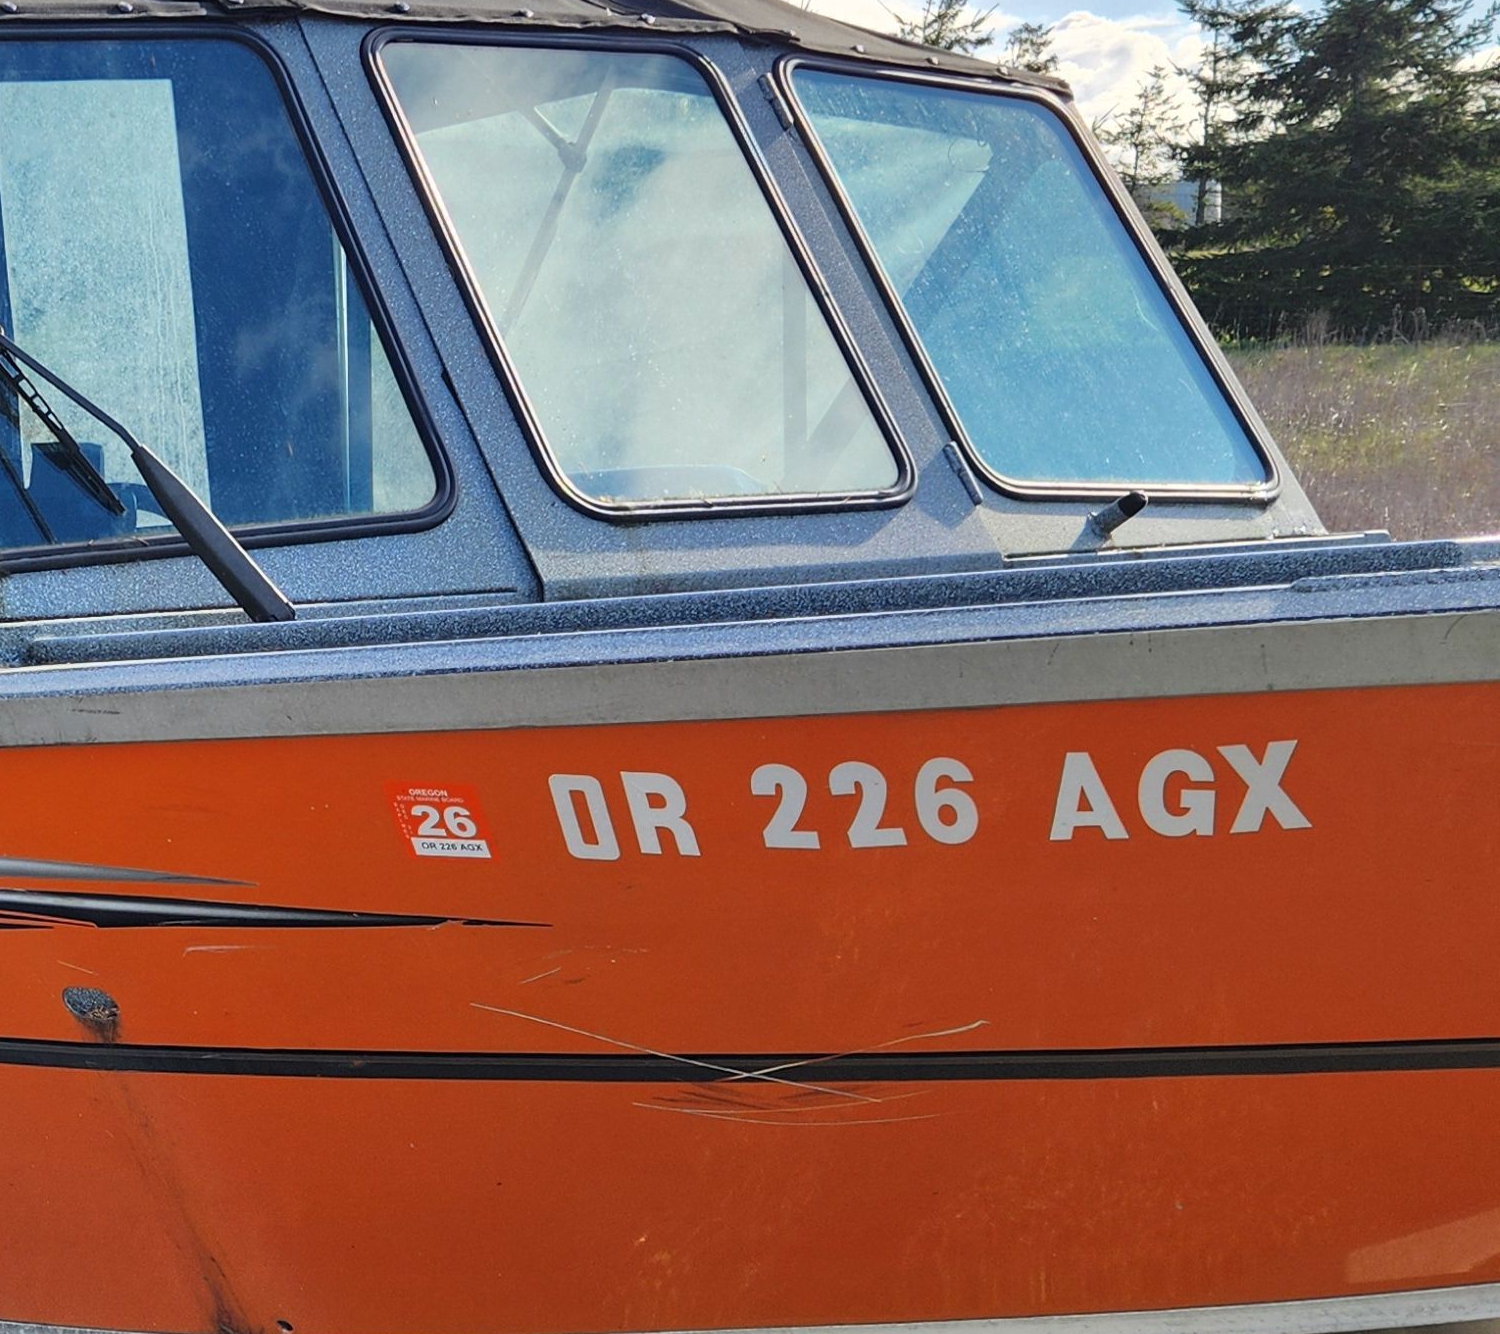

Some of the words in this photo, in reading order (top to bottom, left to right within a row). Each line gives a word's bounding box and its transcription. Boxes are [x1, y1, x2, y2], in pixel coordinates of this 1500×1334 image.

[408, 788, 448, 797] OREGON
[547, 770, 701, 861] OR
[750, 757, 980, 849] 226
[1048, 739, 1312, 841] AGX
[411, 804, 477, 838] 26
[421, 841, 438, 851] OR
[439, 842, 458, 851] 226
[460, 843, 484, 852] AGX
